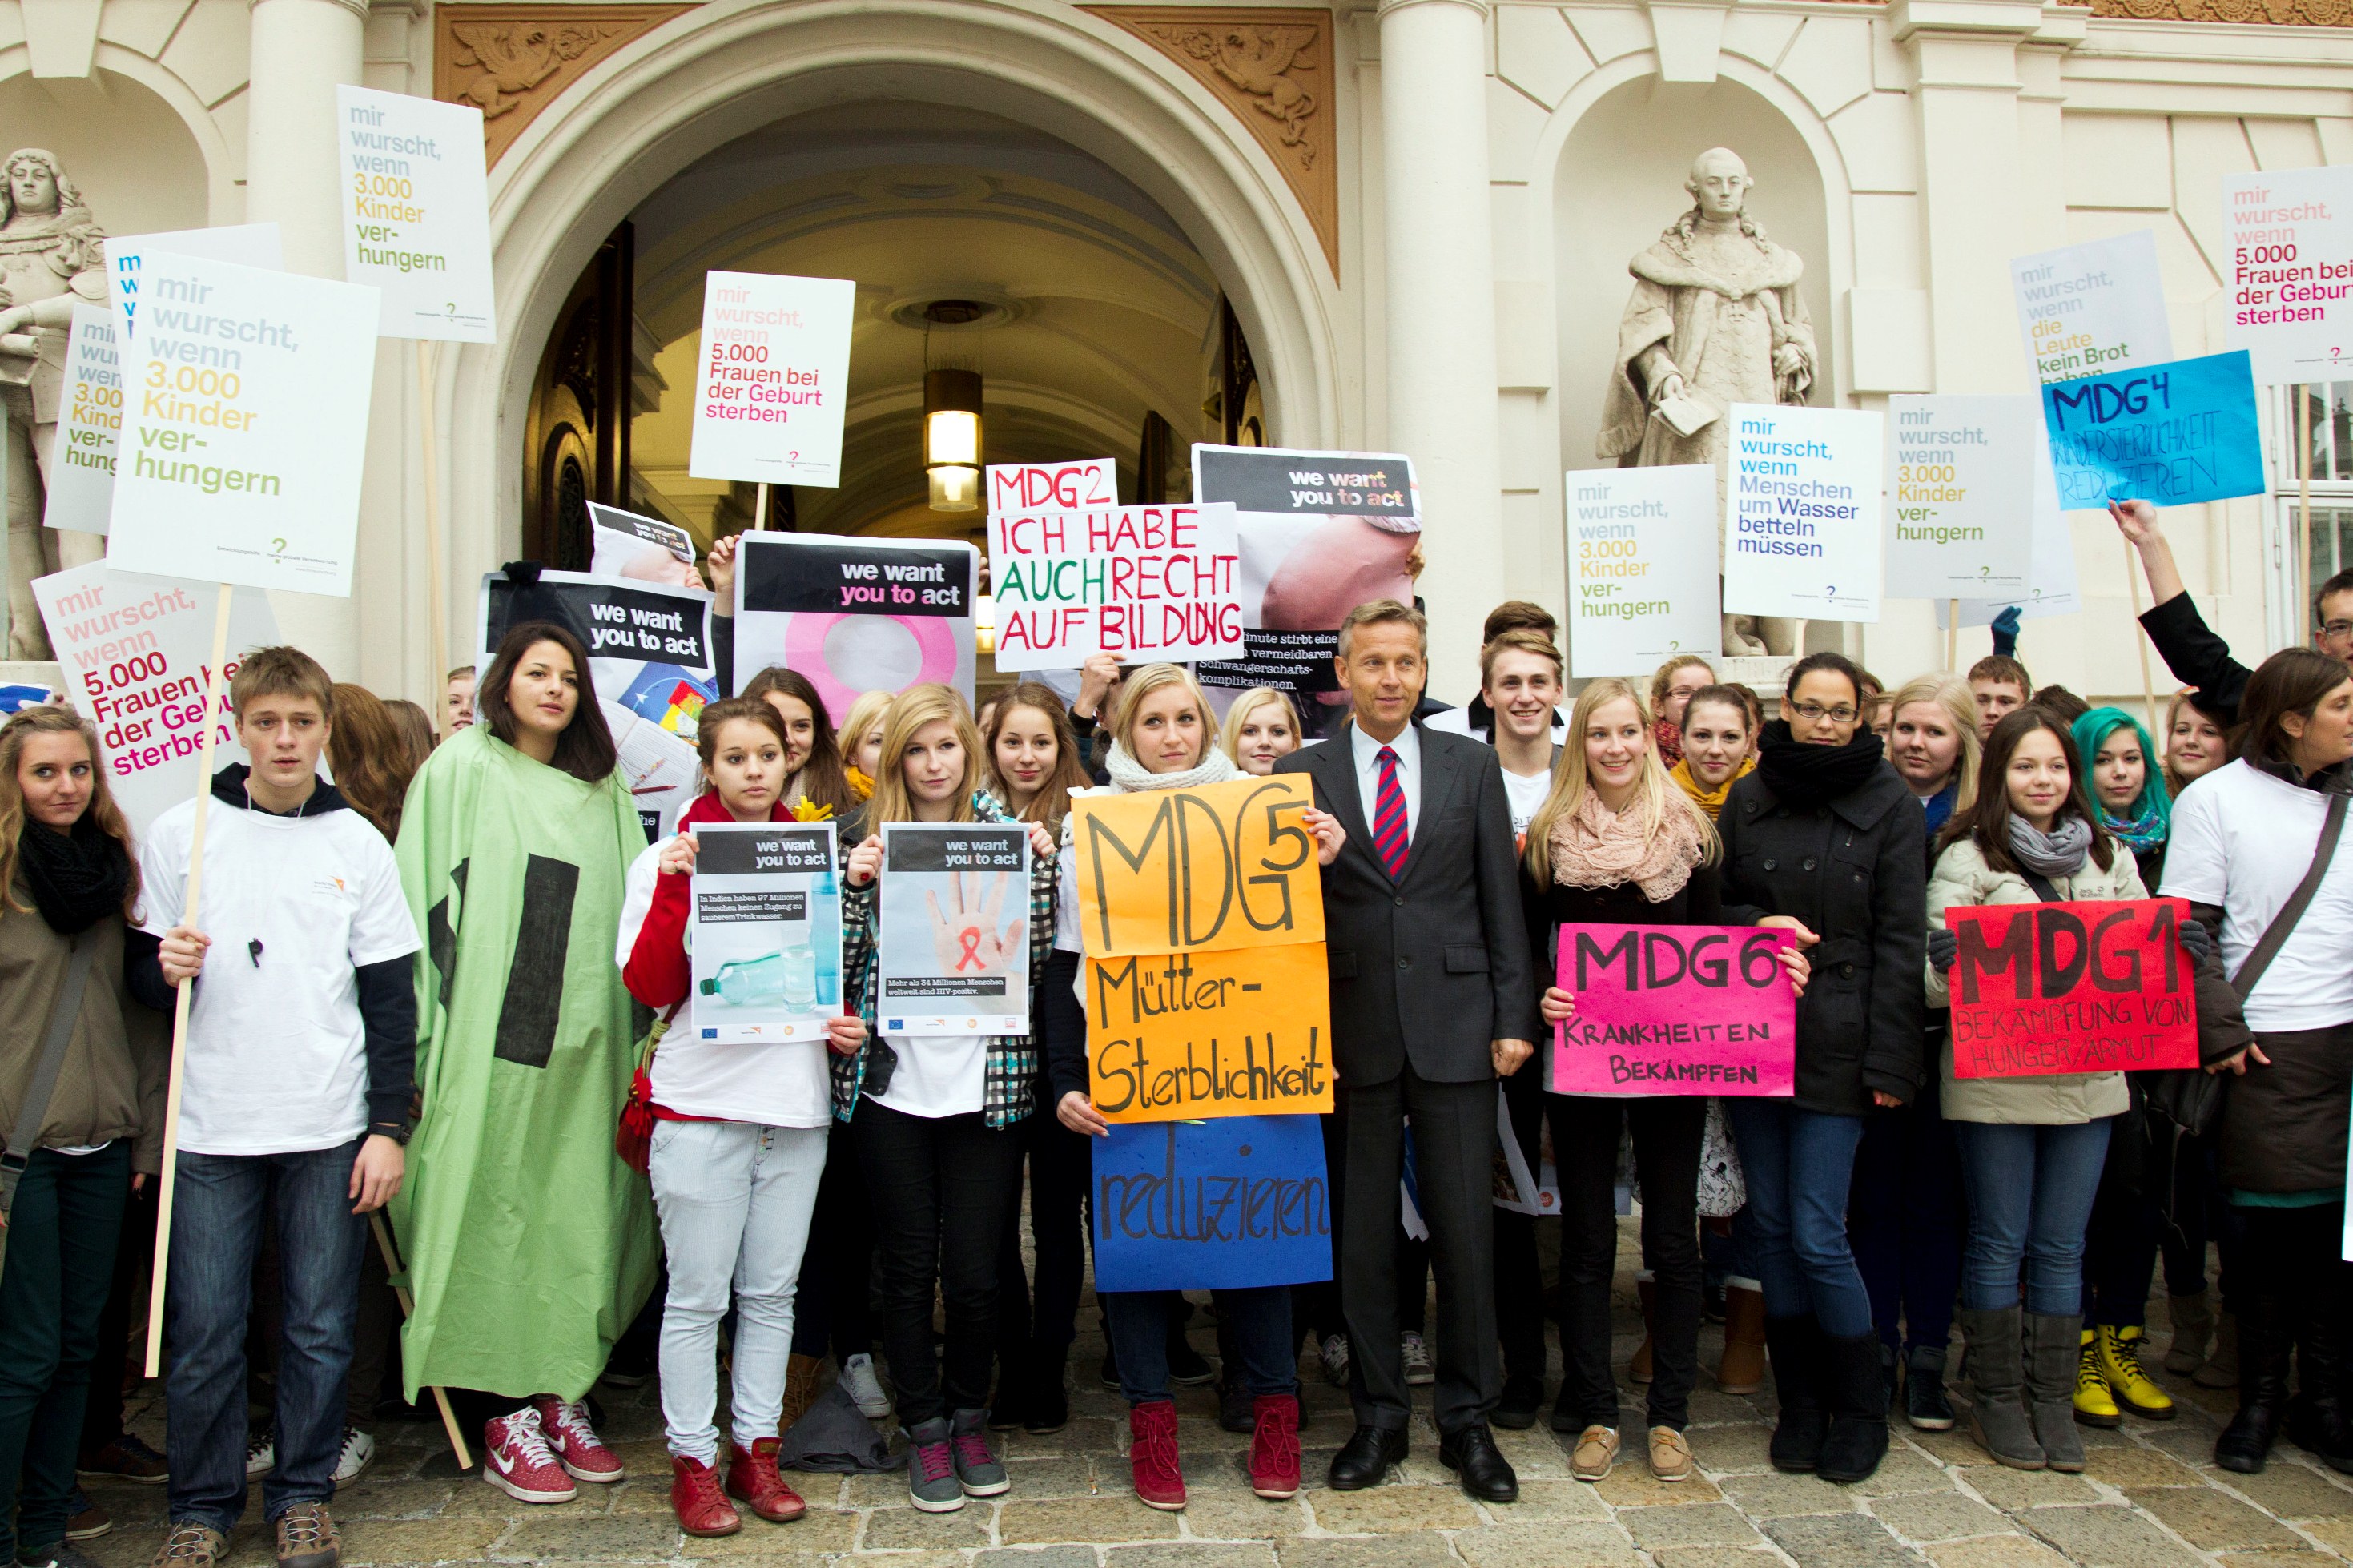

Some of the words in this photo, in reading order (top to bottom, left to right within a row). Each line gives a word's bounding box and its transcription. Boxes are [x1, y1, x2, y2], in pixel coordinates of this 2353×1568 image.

[350, 106, 384, 127] mir
[351, 130, 441, 161] wurscht,
[352, 154, 410, 177] wenn
[354, 173, 412, 199] 3.000
[2234, 186, 2271, 205] mir
[356, 196, 424, 223] Kinder
[2234, 202, 2332, 225] wurscht,
[356, 224, 399, 243] ver-
[2234, 227, 2295, 245] wenn
[357, 242, 446, 272] hungern
[2235, 243, 2297, 265] 5.000
[2021, 264, 2055, 284] mir
[2236, 266, 2313, 285] Frauen
[156, 277, 213, 305] mir
[716, 286, 751, 304] mir
[2024, 271, 2114, 302] wurscht,
[2235, 287, 2274, 305] der
[2280, 283, 2353, 302] Gebur
[714, 308, 804, 329] wurscht,
[2027, 297, 2083, 320] wenn
[2235, 305, 2324, 325] sterben
[152, 307, 300, 352] wurscht,
[713, 326, 769, 344] wenn
[2031, 320, 2063, 338] die
[149, 336, 243, 371] wenn
[711, 343, 769, 363] 5.000
[2034, 333, 2093, 356] Leute
[2037, 353, 2081, 374] kein
[2084, 343, 2130, 364] Brot
[145, 360, 241, 400] 3.000
[710, 361, 781, 384] Frauen
[786, 368, 819, 386] bei
[708, 382, 743, 400] der
[749, 384, 823, 406] Geburt
[2052, 372, 2170, 431] MDG4
[143, 389, 258, 432] Kinder
[706, 403, 788, 423] sterben
[1900, 408, 1934, 425] mir
[1741, 418, 1776, 435] mir
[1899, 427, 1988, 446] wurscht,
[69, 428, 114, 448] ver-
[139, 426, 208, 453] ver-
[1740, 440, 1832, 461] wurscht,
[1898, 450, 1954, 464] wenn
[135, 450, 280, 496] hungern
[1289, 472, 1324, 486] we
[1328, 470, 1387, 488] want
[1740, 460, 1798, 476] wenn
[1898, 465, 1955, 483] 3.000
[995, 465, 1111, 510] MDG2
[1290, 490, 1333, 508] you
[1337, 488, 1362, 505] to
[1366, 490, 1404, 507] act
[1578, 483, 1611, 501] mir
[1739, 475, 1852, 500] Menschen
[1898, 484, 1966, 502] Kinder
[1578, 500, 1669, 520] wurscht,
[1739, 499, 1772, 514] um
[1777, 497, 1859, 520] Wasser
[1896, 507, 1938, 521] ver-
[633, 522, 650, 531] we
[650, 526, 678, 541] want
[1000, 516, 1065, 554] ICH
[1088, 509, 1199, 553] HABE
[1579, 524, 1635, 539] wenn
[1738, 515, 1815, 537] betteln
[1896, 523, 1984, 545] hungern
[636, 529, 656, 540] you
[656, 533, 668, 544] to
[669, 539, 686, 549] act
[1579, 540, 1637, 559] 3.000
[1738, 535, 1823, 557] müssen
[841, 563, 879, 581] we
[883, 563, 945, 583] want
[1580, 560, 1650, 578] Kinder
[56, 585, 104, 617] mir
[840, 586, 885, 606] you
[890, 584, 916, 604] to
[922, 585, 961, 605] act
[1580, 583, 1622, 597] ver-
[63, 587, 196, 643] wurscht,
[590, 603, 626, 623] we
[630, 609, 683, 632] want
[1581, 600, 1670, 620] hungern
[1000, 607, 1089, 651] AUF
[1100, 602, 1241, 650] BILDUNG
[73, 629, 158, 669] wenn
[590, 627, 635, 649] you
[638, 629, 661, 650] to
[665, 637, 699, 657] act
[1244, 632, 1277, 644] inute
[1280, 633, 1313, 645] stirbt
[1315, 634, 1337, 644] eine
[1251, 649, 1333, 660] vermeidbaren
[83, 651, 167, 697] 5.000
[1199, 660, 1313, 674] Schwangerschafts-
[1199, 673, 1297, 690] komplikationen.
[91, 674, 199, 723] Frauen
[104, 717, 153, 750] der
[756, 842, 779, 852] we
[782, 838, 817, 852] want
[946, 842, 967, 851] we
[971, 839, 1008, 851] want
[755, 856, 784, 869] you
[786, 853, 802, 866] to
[804, 852, 827, 866] act
[945, 854, 972, 868] you
[975, 853, 991, 865] to
[993, 853, 1018, 865] act
[764, 903, 791, 911] Zugang
[1576, 931, 1778, 991] MDG6
[1958, 904, 2178, 1004] MDG1
[936, 988, 979, 996] HIV-positiv.
[1096, 953, 1262, 1029] Mütter-
[2142, 996, 2191, 1027] VON
[1562, 1016, 1770, 1048] KRANKHEITEN
[1096, 1027, 1325, 1113] Sterblichkeit
[1609, 1055, 1758, 1084] BEKÄMPFEN
[1100, 1120, 1331, 1242] reduzieren
